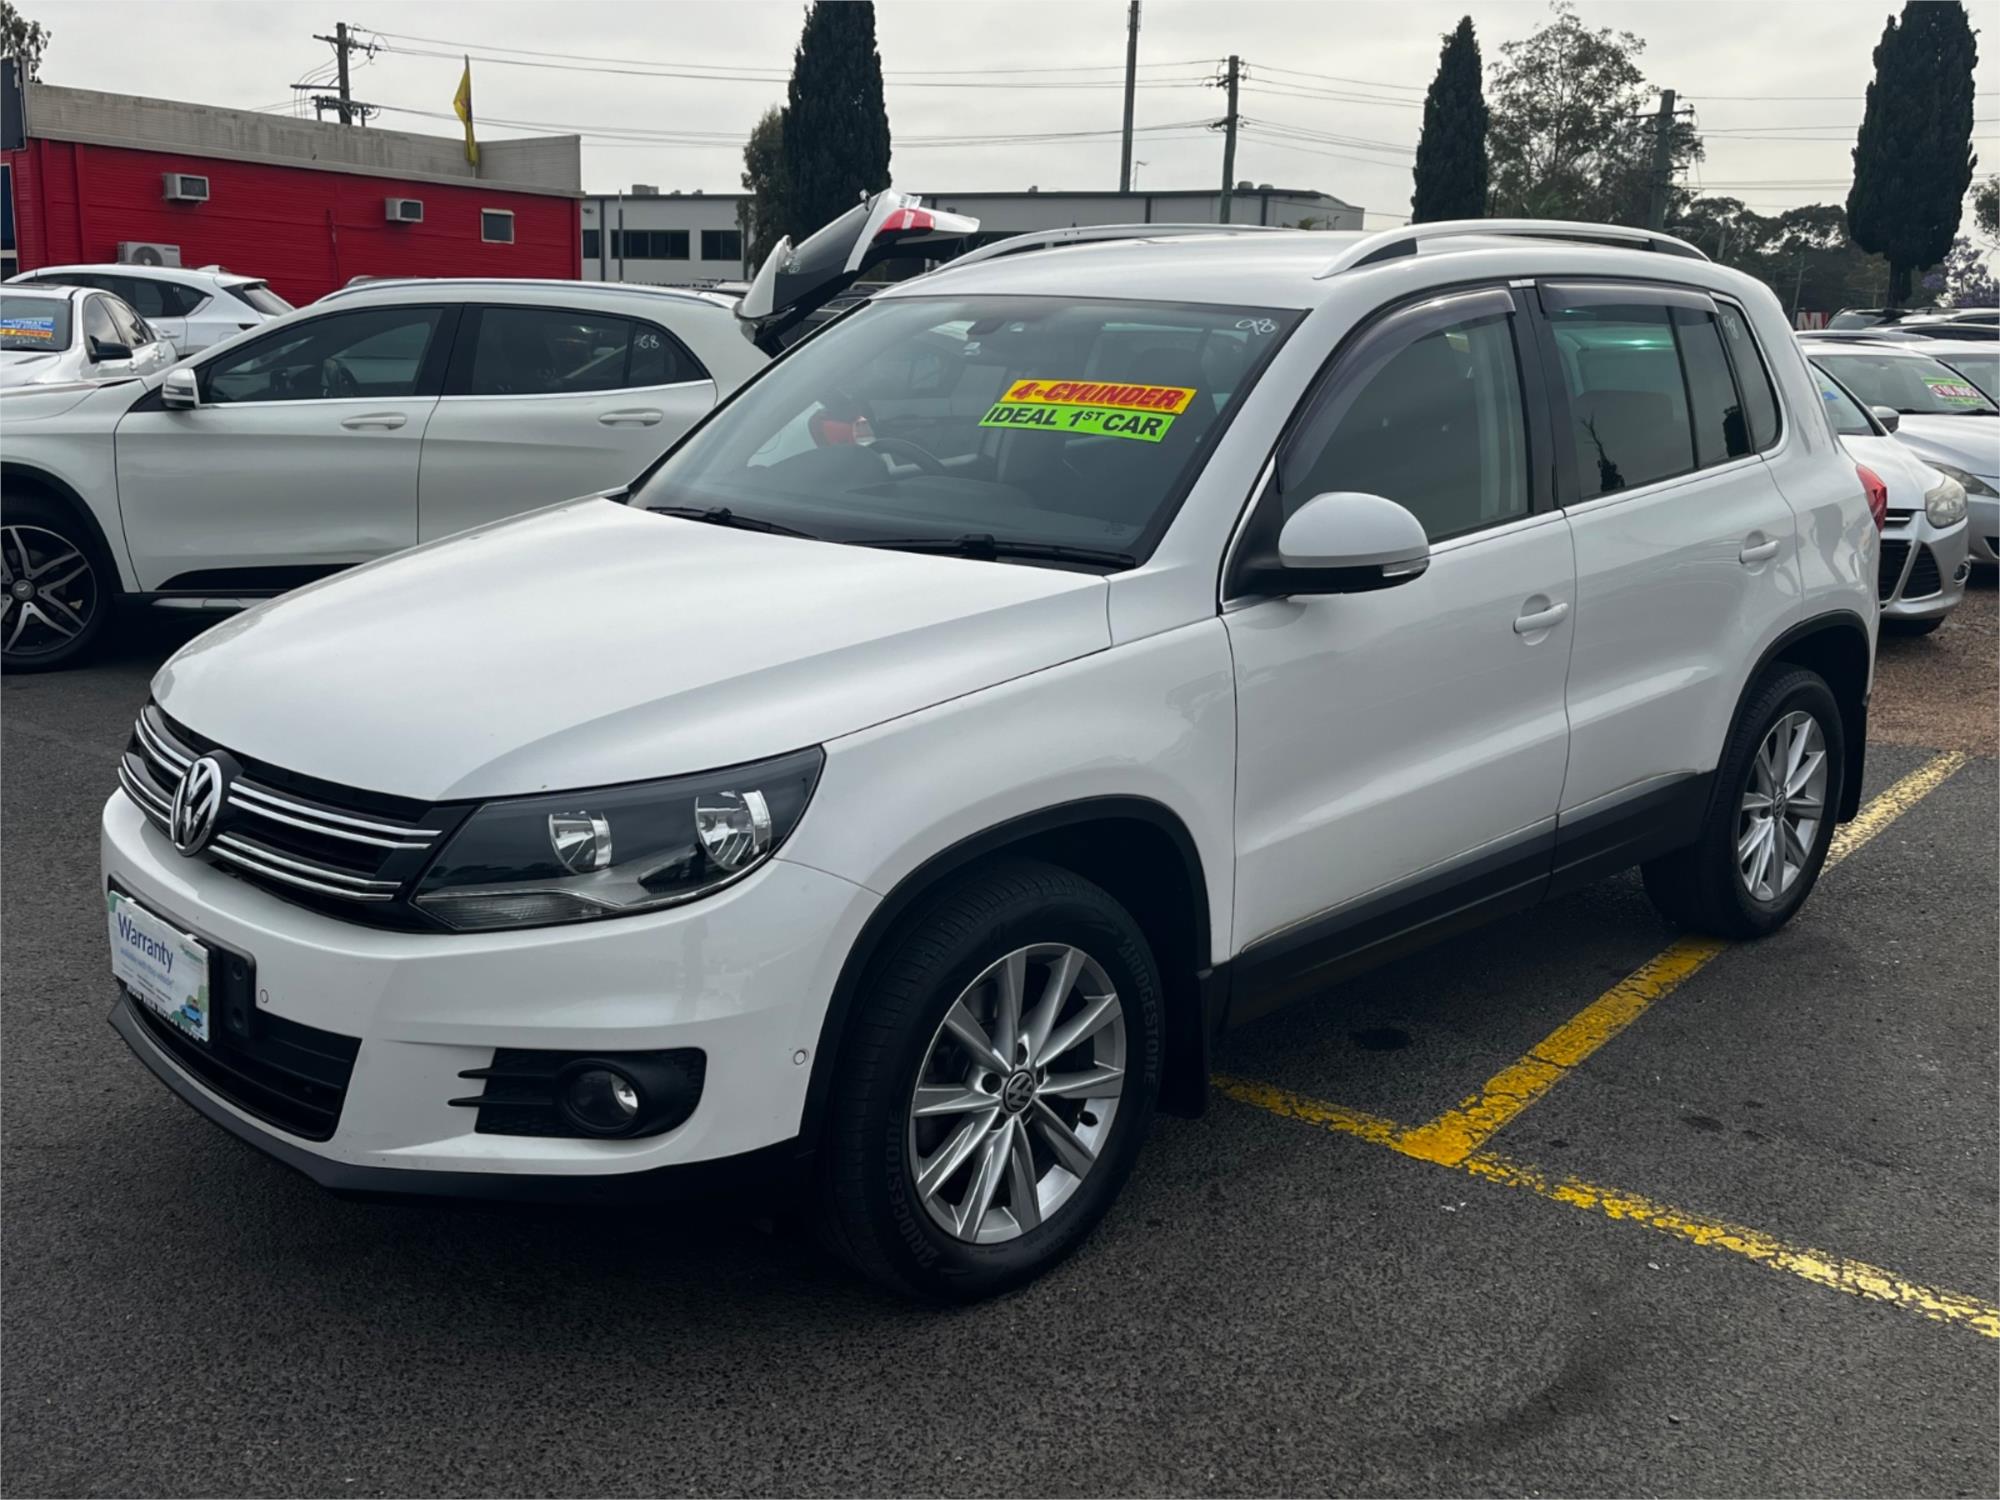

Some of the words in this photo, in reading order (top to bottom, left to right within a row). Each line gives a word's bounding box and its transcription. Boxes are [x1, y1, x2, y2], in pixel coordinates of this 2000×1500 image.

[1235, 317, 1277, 335] 98
[1010, 381, 1187, 410] 4-CYLINDER
[983, 406, 1057, 426] IDEAL
[1102, 413, 1164, 437] CAR
[117, 911, 174, 974] Warranty
